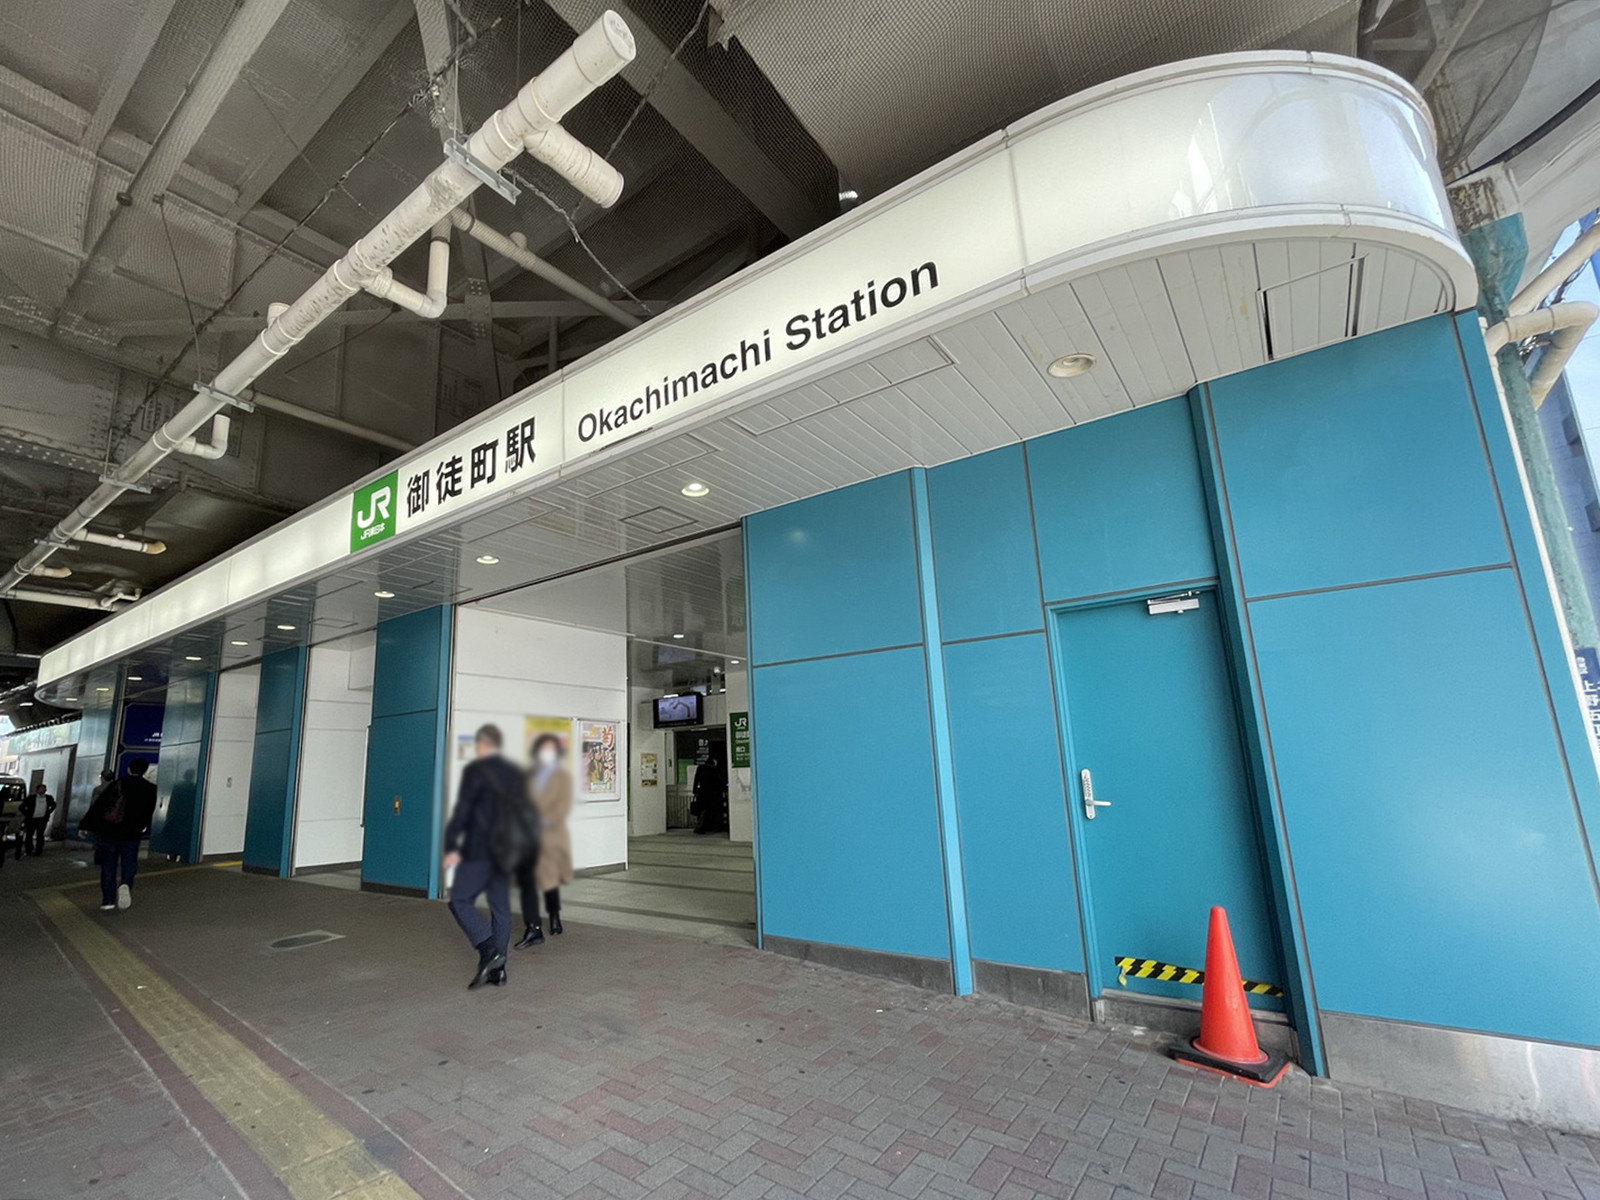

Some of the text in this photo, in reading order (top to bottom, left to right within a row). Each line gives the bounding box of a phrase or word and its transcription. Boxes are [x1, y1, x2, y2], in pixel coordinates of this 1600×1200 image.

[577, 261, 939, 443] Okachimachi Station
[406, 416, 536, 518] 御徒町駅
[357, 486, 391, 528] JR
[734, 717, 747, 727] JR
